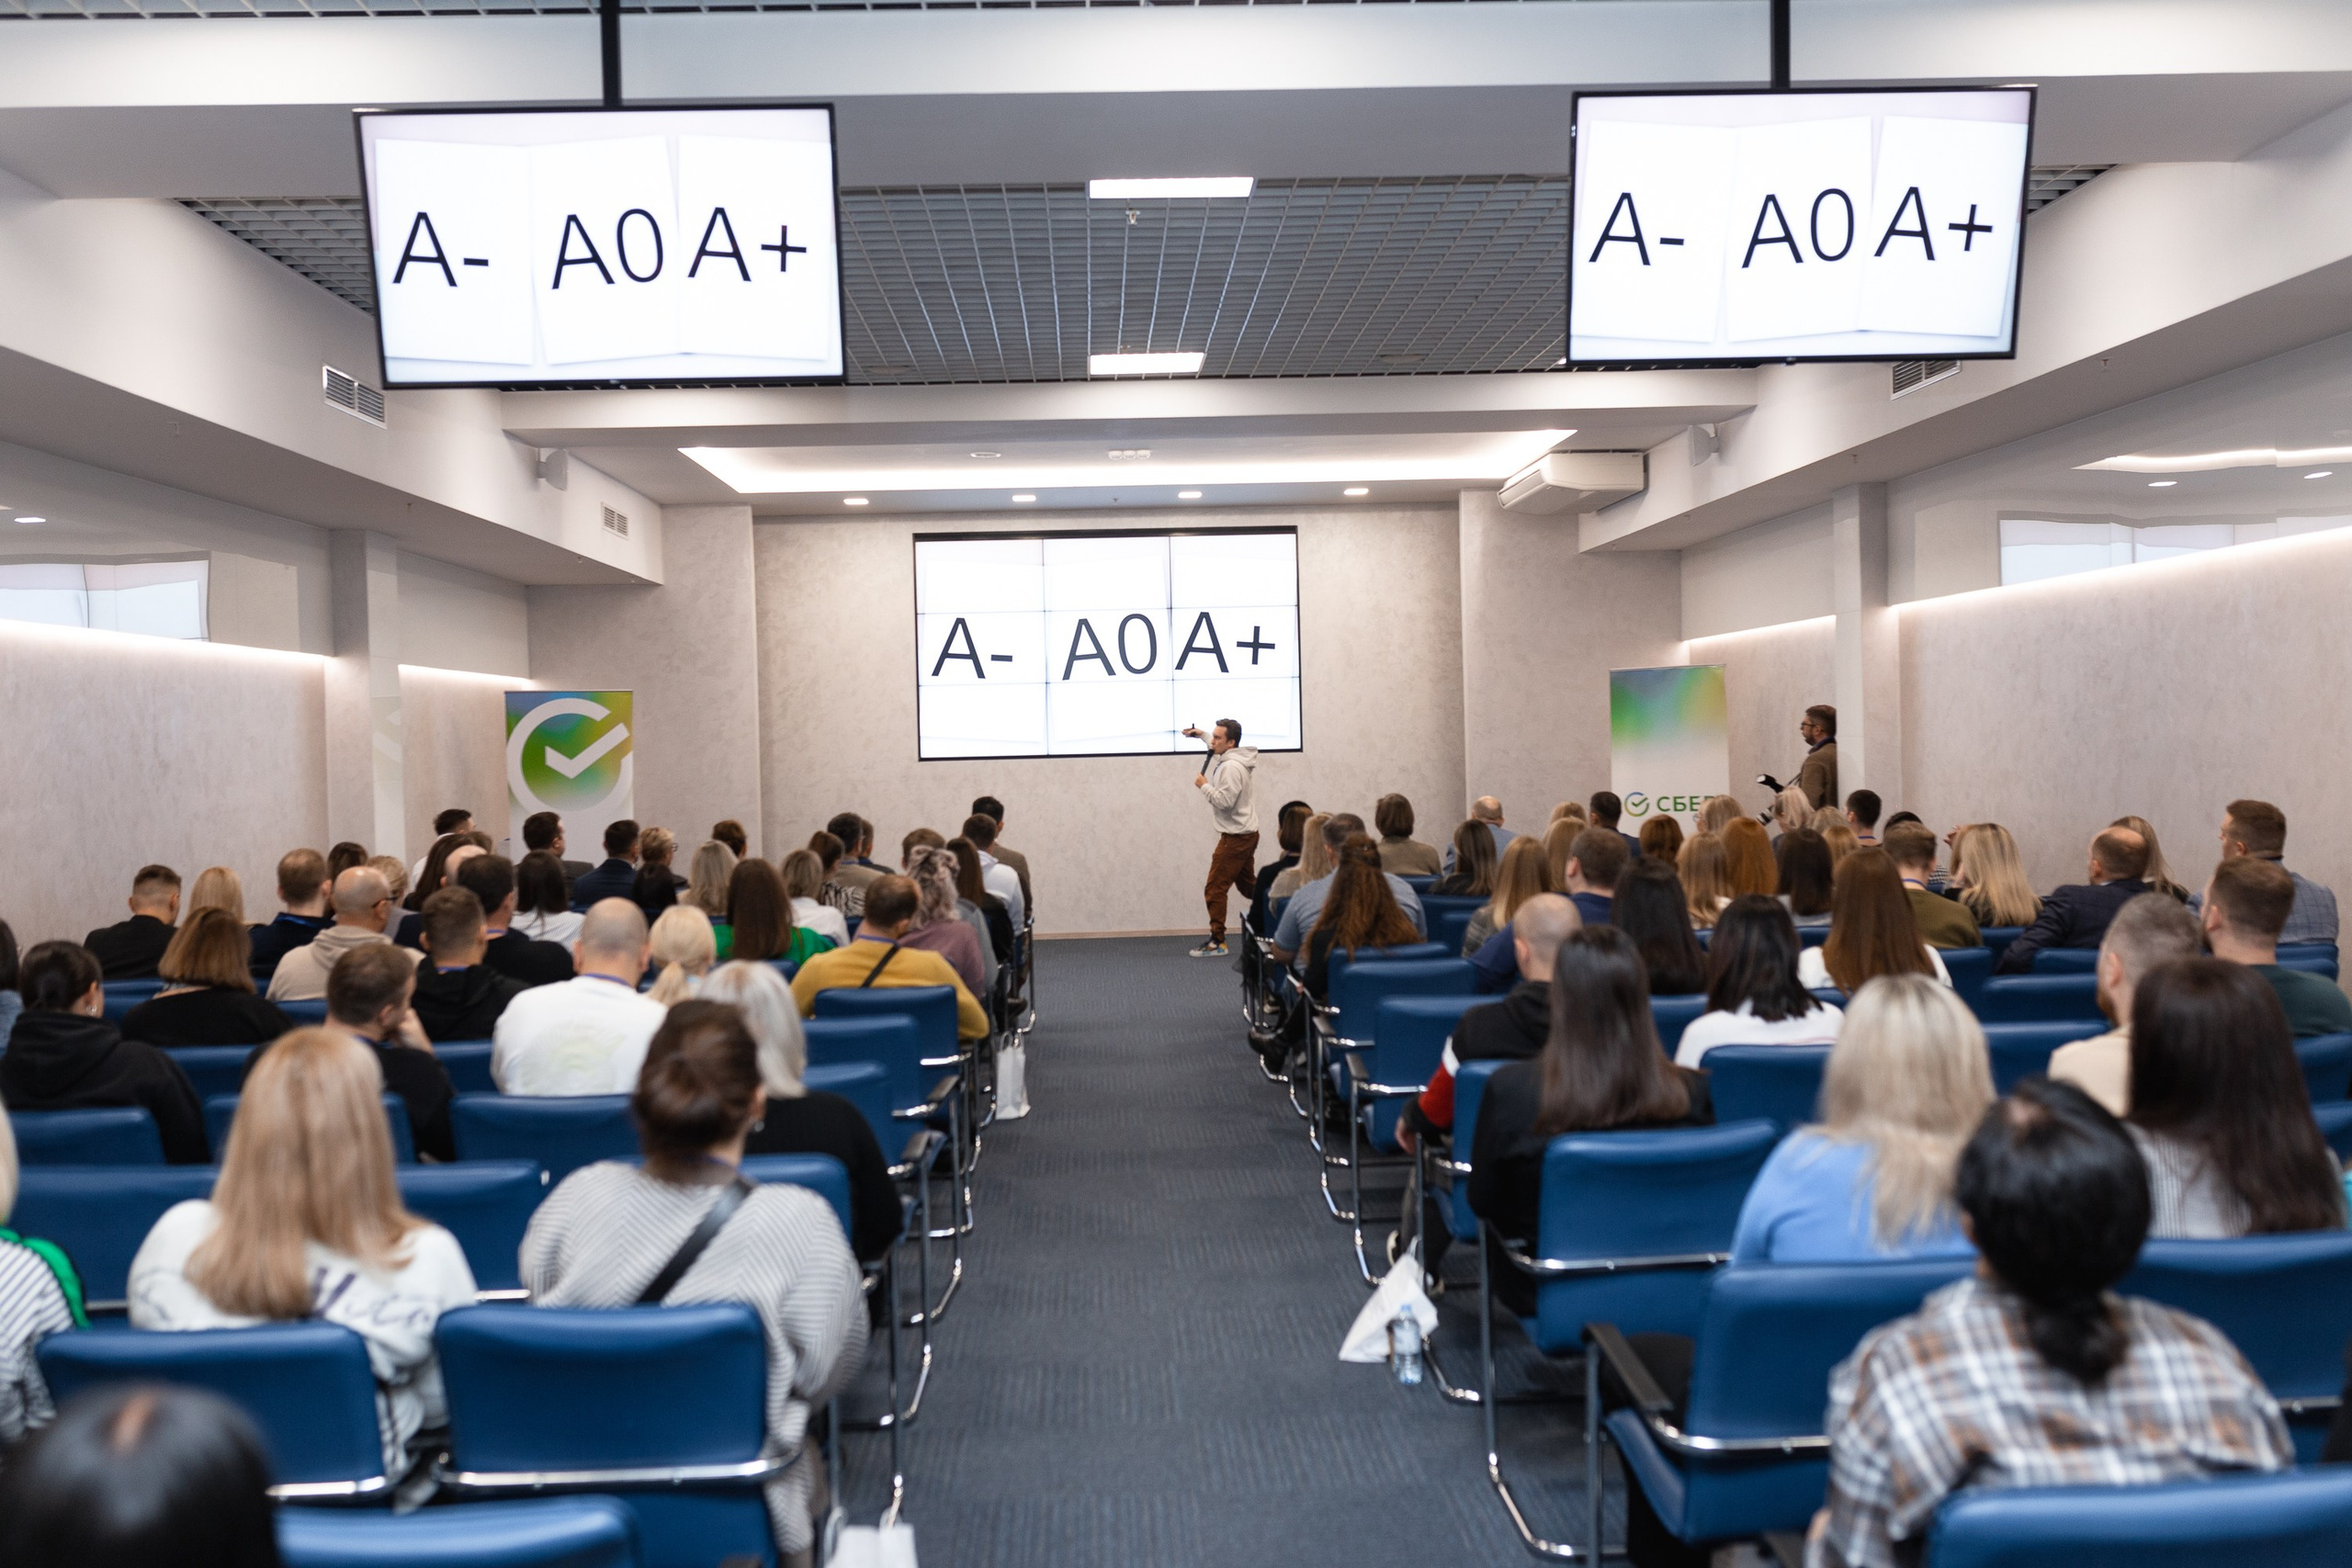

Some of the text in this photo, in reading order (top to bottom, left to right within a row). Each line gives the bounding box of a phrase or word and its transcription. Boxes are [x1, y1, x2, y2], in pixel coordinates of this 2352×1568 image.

[393, 211, 489, 287] A-
[687, 207, 808, 282] A+
[1589, 192, 1685, 266] A-
[1873, 186, 1993, 261] A+
[931, 617, 1013, 679] A-
[1174, 611, 1276, 673] A+
[1657, 795, 1715, 812] СБЕ
